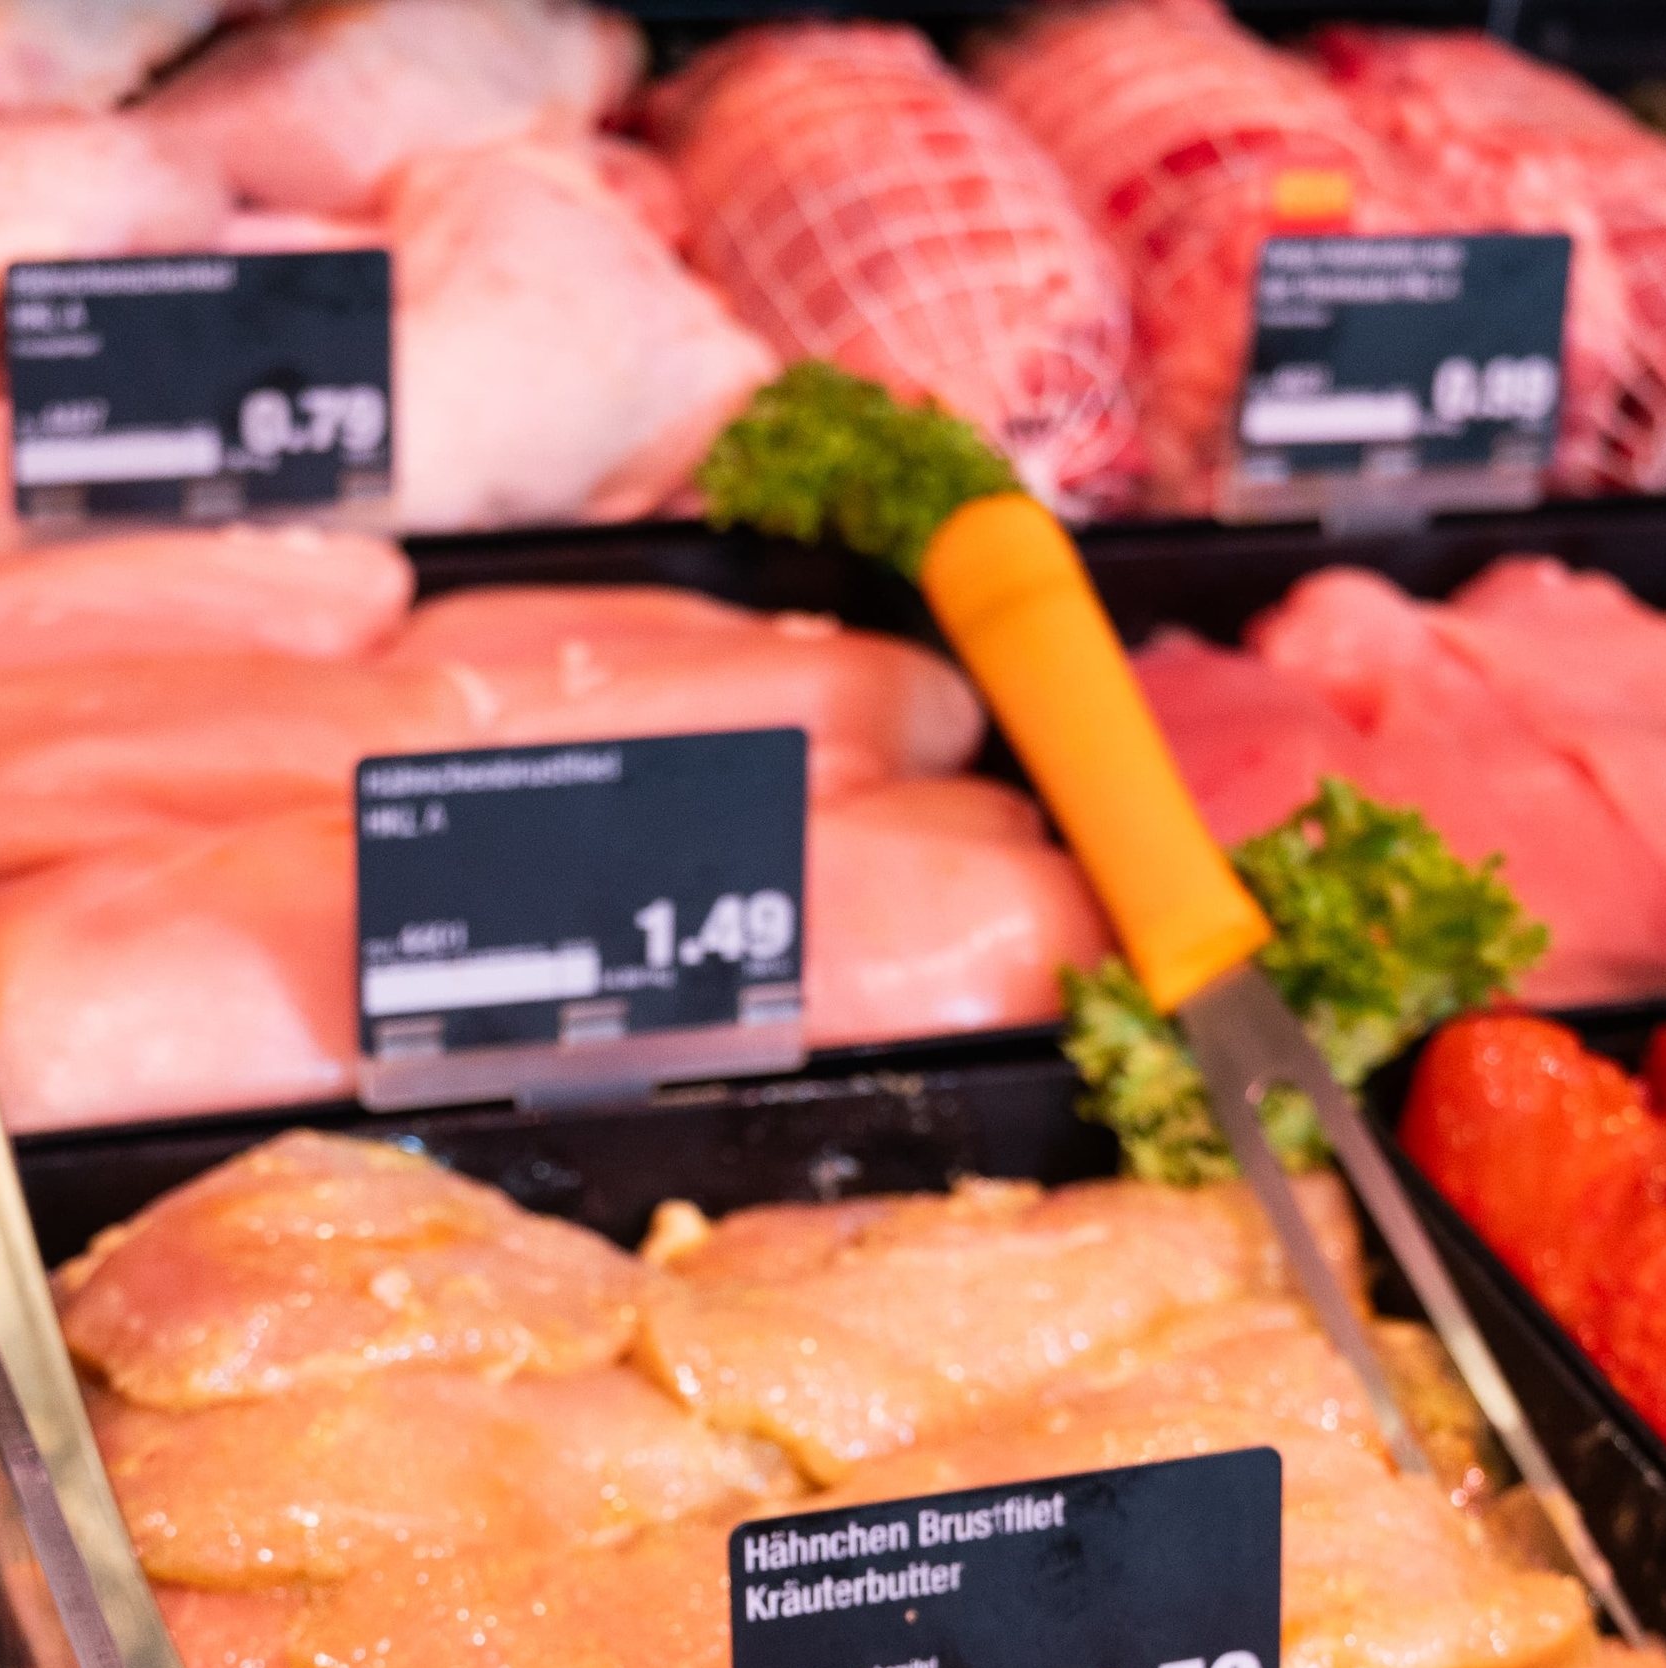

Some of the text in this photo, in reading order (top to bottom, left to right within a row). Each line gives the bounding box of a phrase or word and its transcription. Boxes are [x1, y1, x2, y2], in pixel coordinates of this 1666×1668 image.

[634, 888, 796, 969] 1.49
[743, 1491, 1066, 1574] Hähnchen Brustfilet
[744, 1560, 964, 1623] Kräuterbutter
